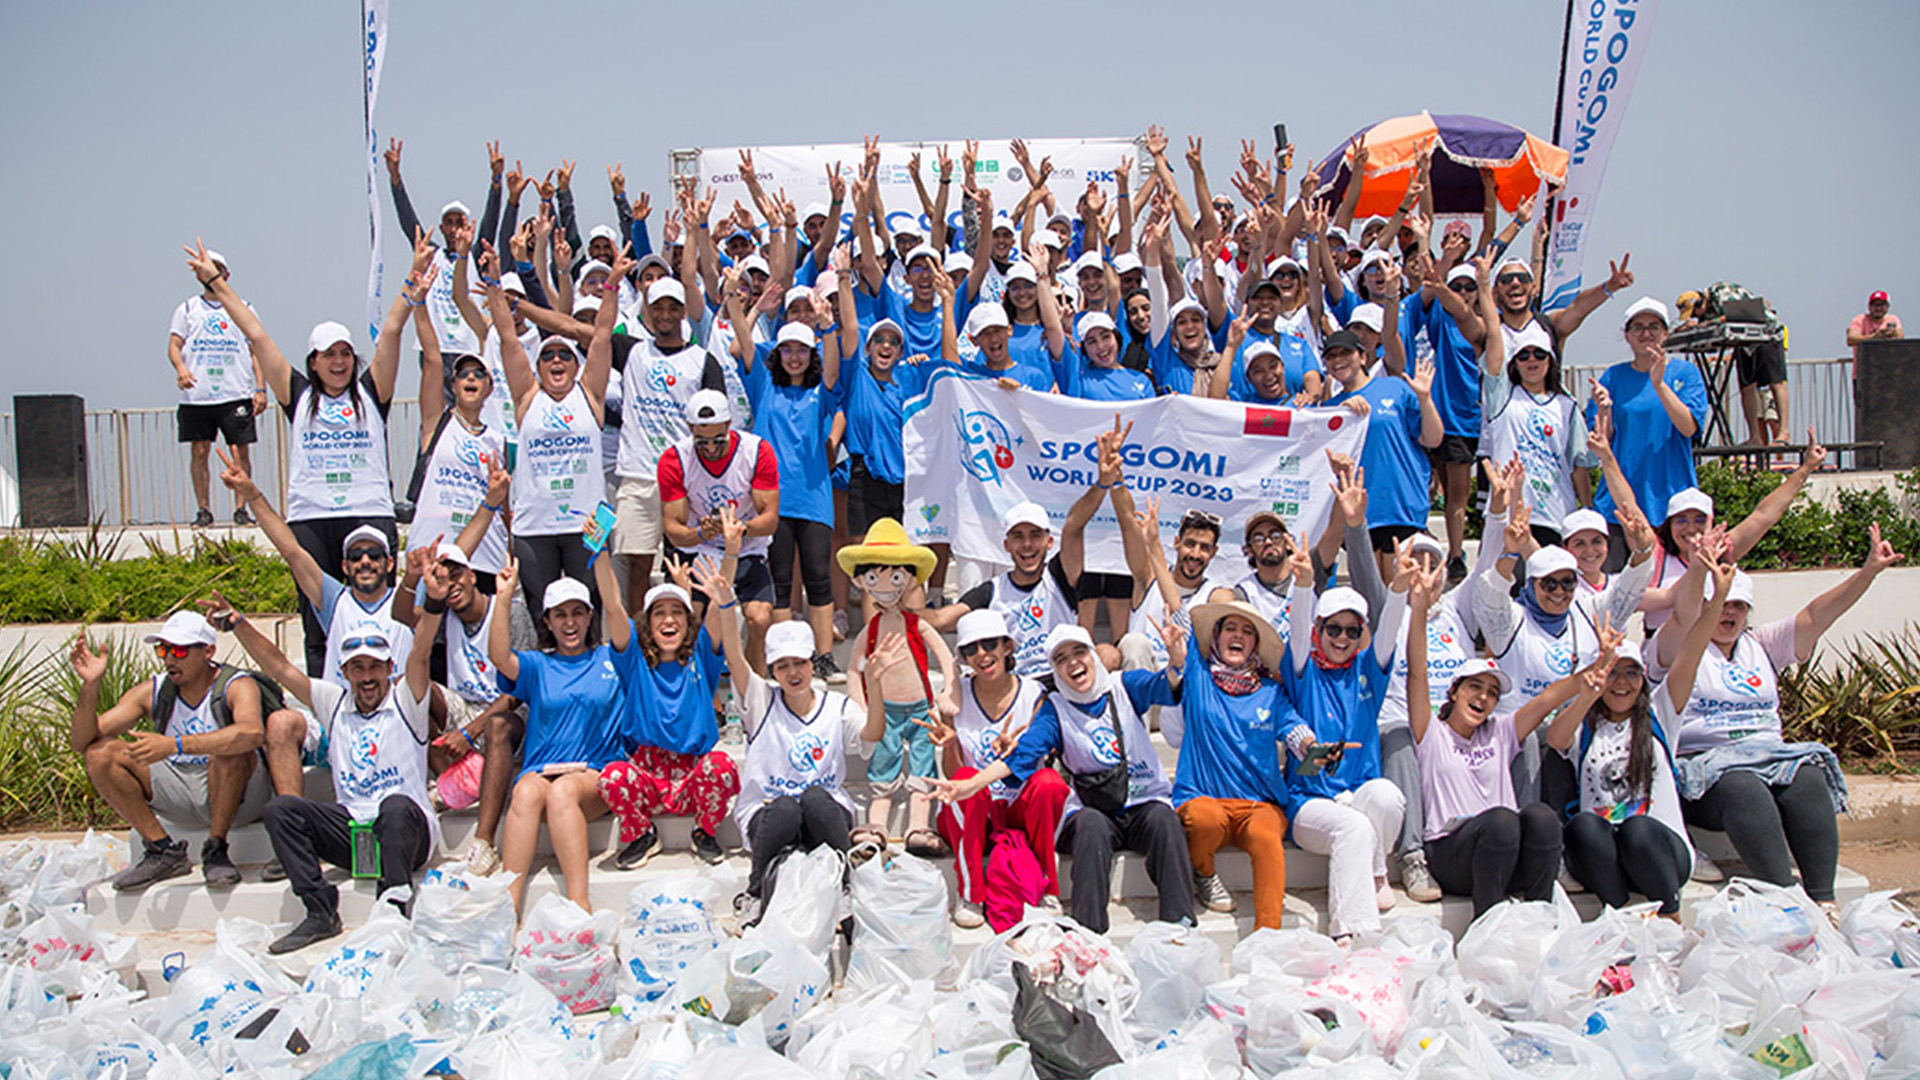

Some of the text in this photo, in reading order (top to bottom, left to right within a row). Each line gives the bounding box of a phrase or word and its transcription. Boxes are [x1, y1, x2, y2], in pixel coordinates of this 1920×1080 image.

[1583, 0, 1606, 64] ORLD
[1573, 0, 1639, 165] POGOMI
[303, 430, 369, 441] SPOGOMI
[1026, 465, 1099, 487] WORL
[1124, 475, 1168, 493] CUP
[1170, 479, 1235, 503] 2023
